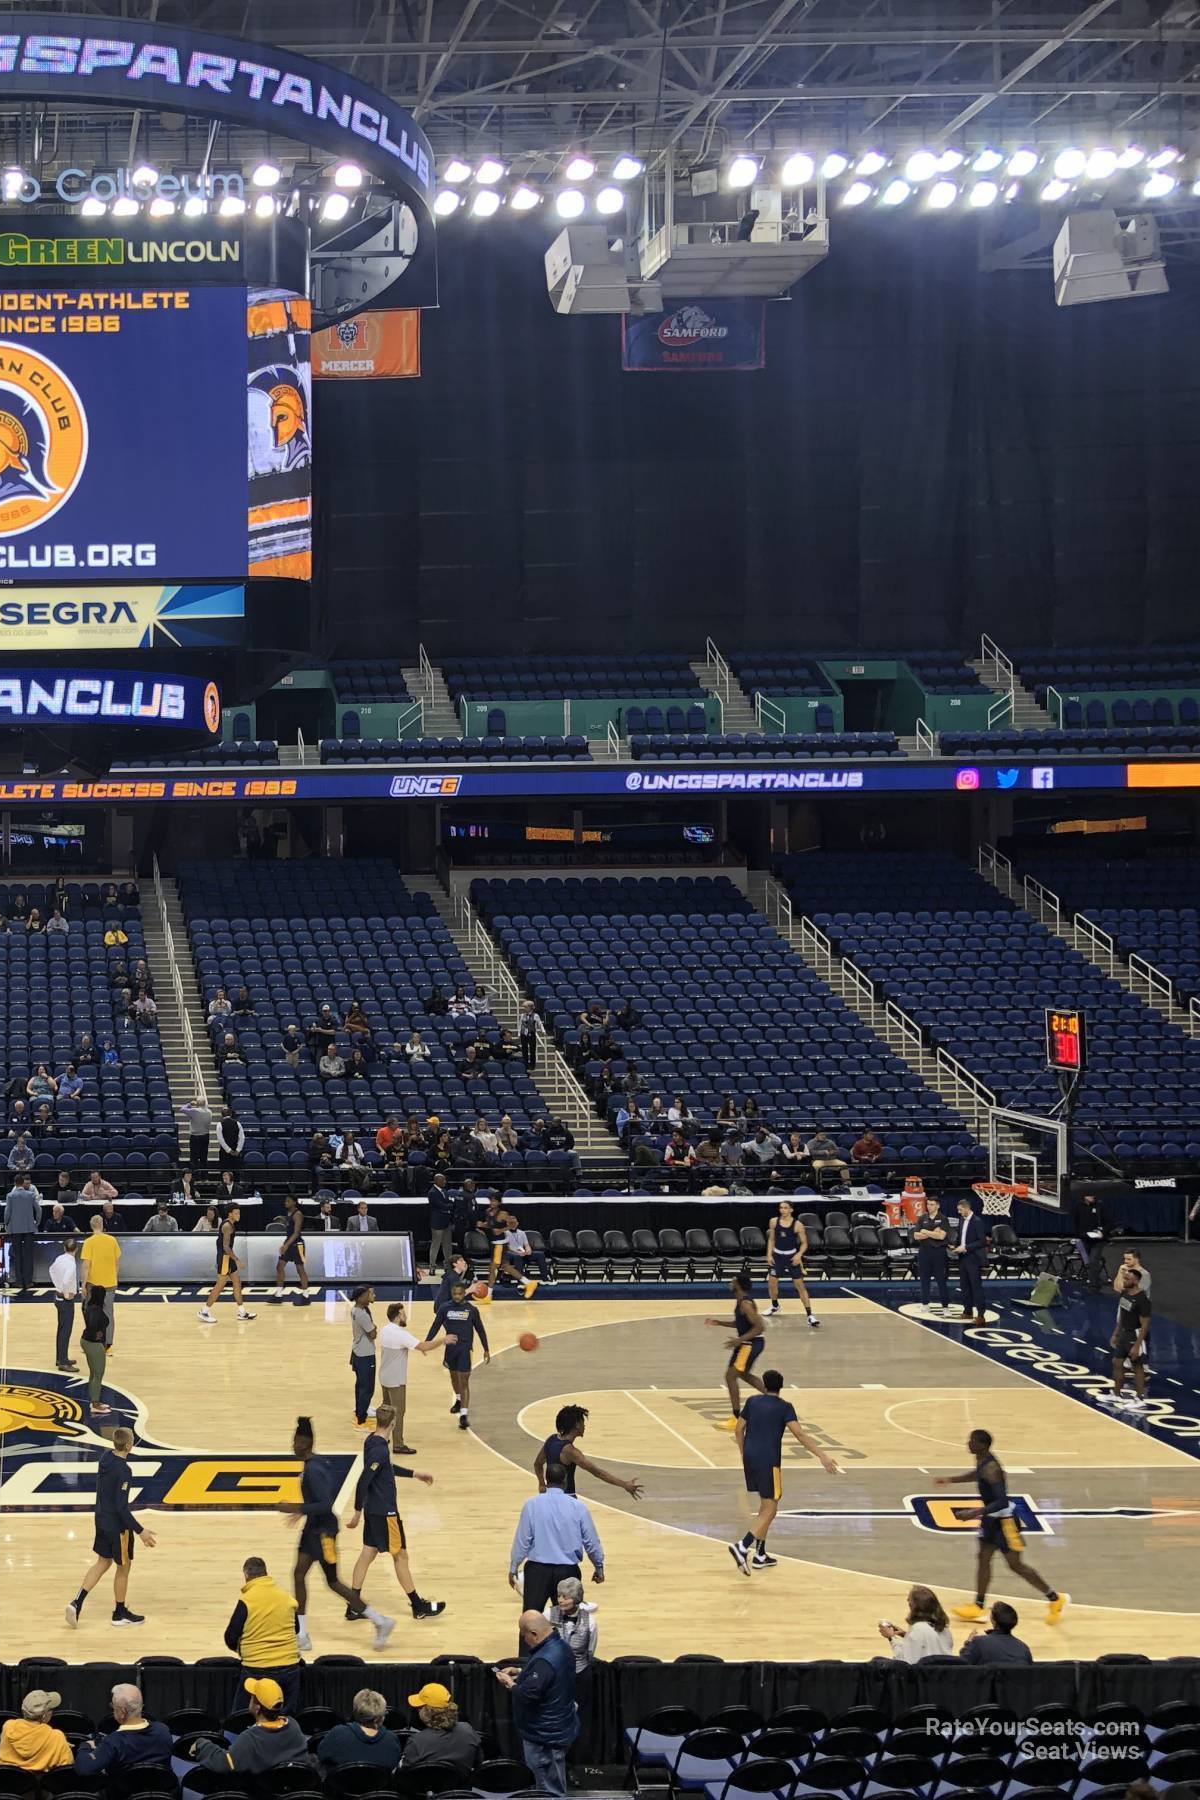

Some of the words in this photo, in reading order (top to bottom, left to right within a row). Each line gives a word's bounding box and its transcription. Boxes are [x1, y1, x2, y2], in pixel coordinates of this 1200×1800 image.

[127, 240, 240, 263] LINCOLN
[663, 327, 728, 338] SAMFORD
[321, 360, 375, 372] MERCER
[28, 371, 71, 431] CLUB
[0, 601, 138, 625] SEGRA
[61, 782, 166, 798] SUCCESS
[171, 781, 236, 797] SINCE
[391, 774, 462, 797] UNCG
[625, 771, 864, 791] @UNCGSPARTANCLUB
[1134, 1178, 1176, 1188] SPALDING
